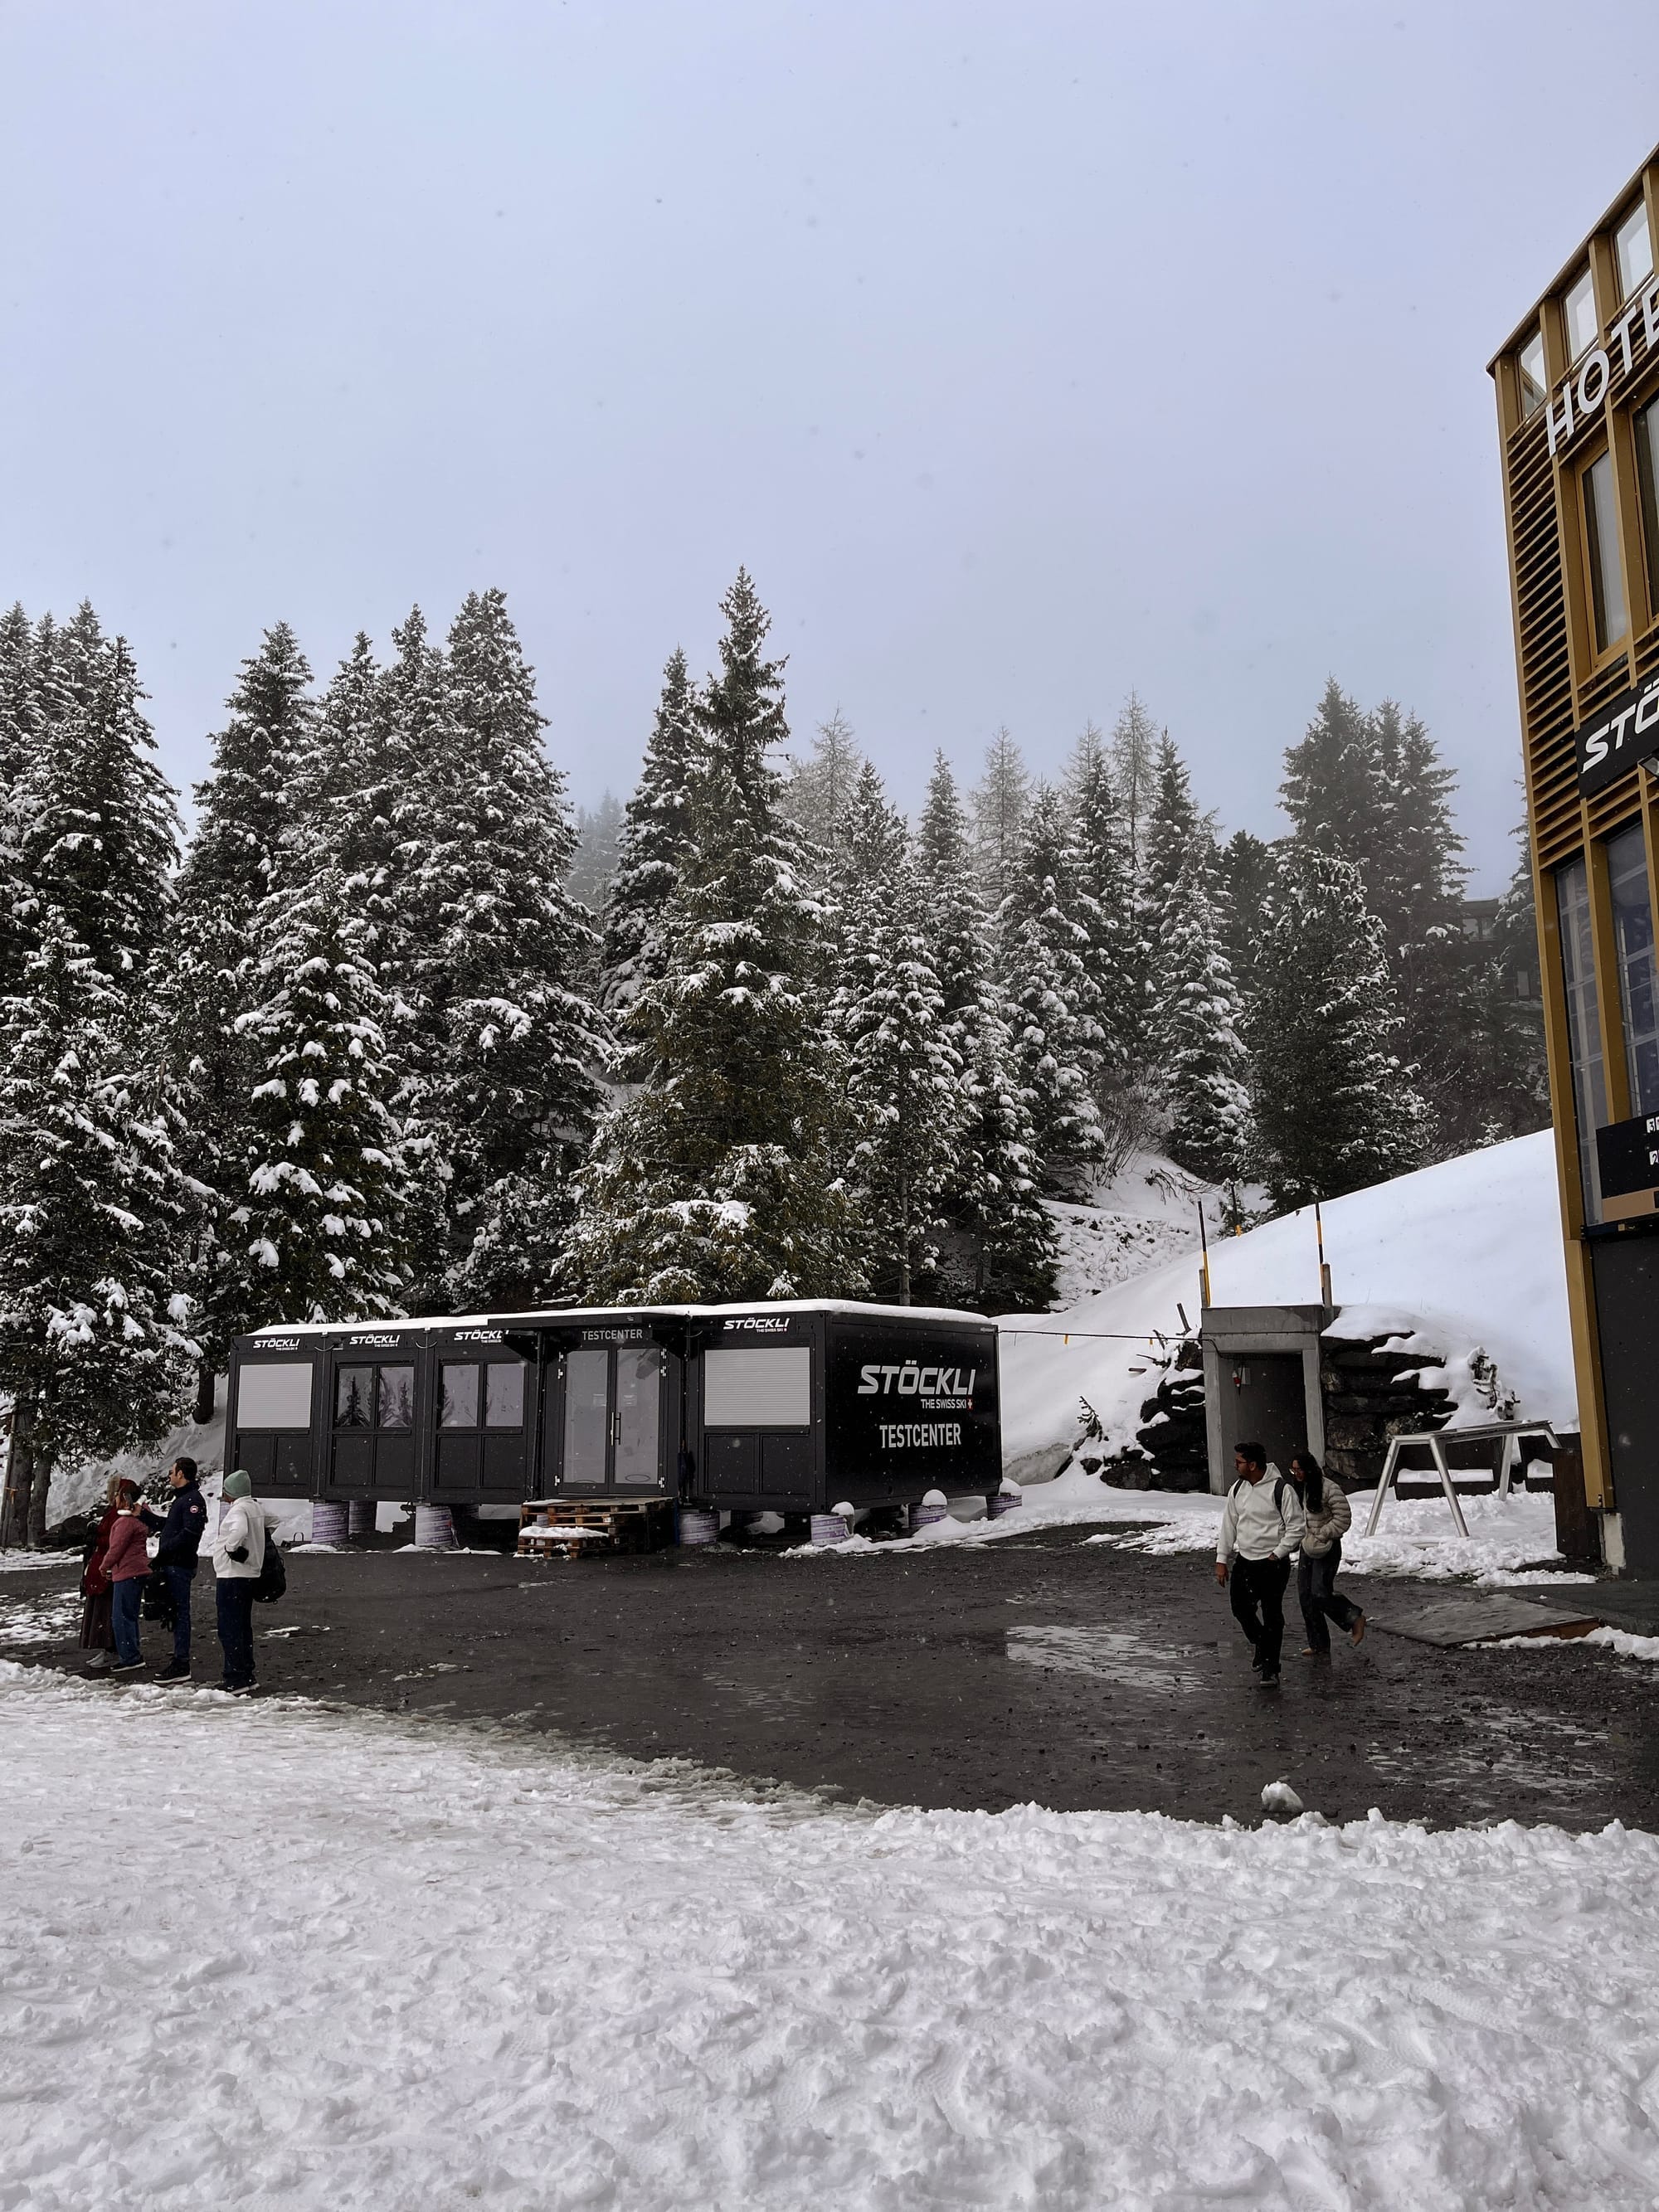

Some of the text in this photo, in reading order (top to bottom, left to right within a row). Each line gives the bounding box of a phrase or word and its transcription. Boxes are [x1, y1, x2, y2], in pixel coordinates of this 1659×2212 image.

[1545, 276, 1659, 456] HOTE
[723, 1317, 791, 1330] STÖCKLI
[349, 1334, 401, 1344] STÖCKLI
[581, 1329, 643, 1340] TESTCENTER
[253, 1338, 300, 1349] STÖCKLI
[857, 1359, 976, 1395] STÖCKLI
[921, 1398, 966, 1409] THE SWISS SKI
[879, 1423, 961, 1448] TESTCENTER
